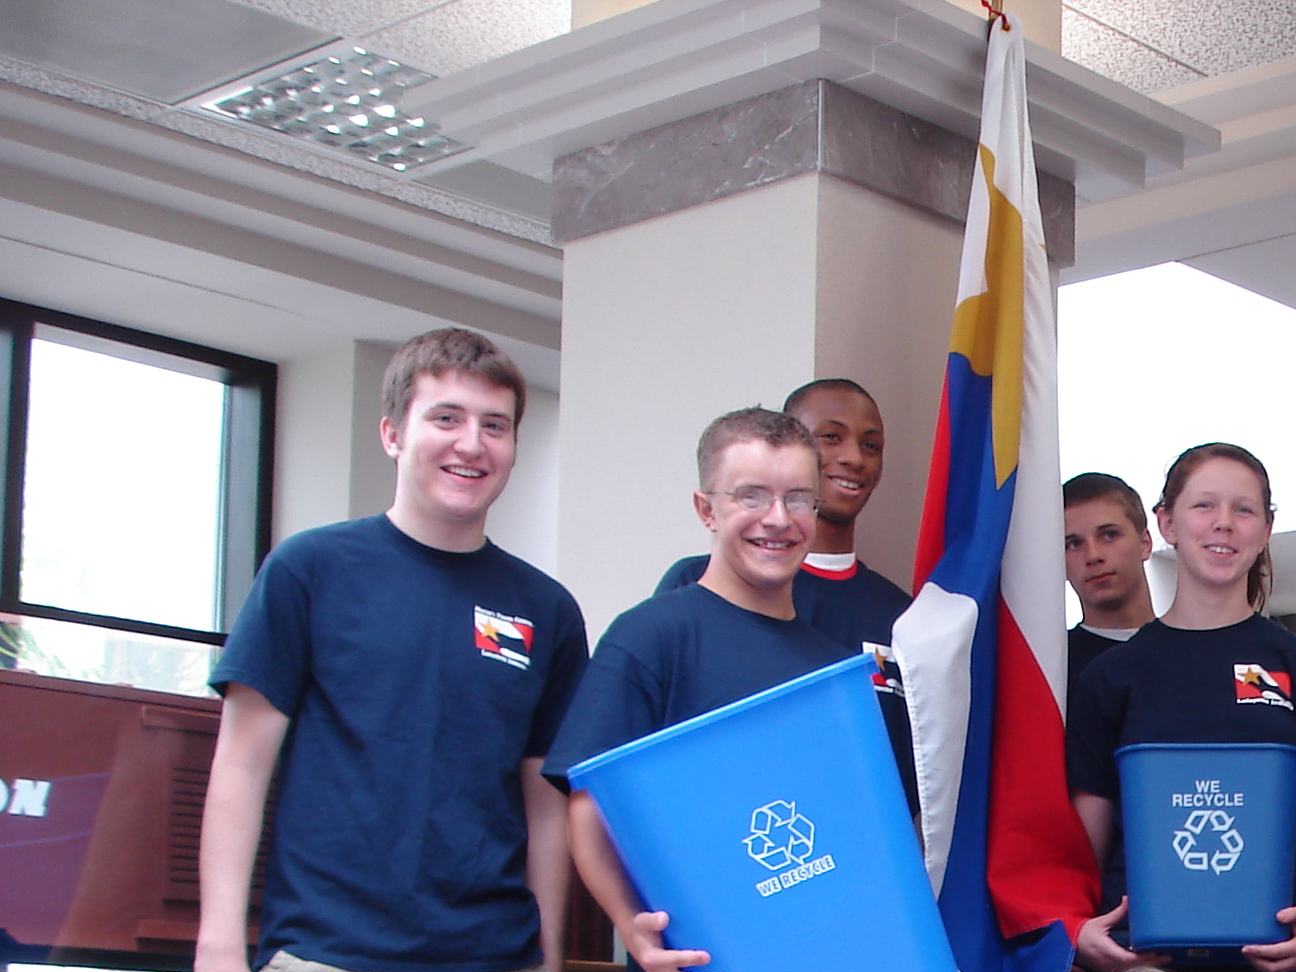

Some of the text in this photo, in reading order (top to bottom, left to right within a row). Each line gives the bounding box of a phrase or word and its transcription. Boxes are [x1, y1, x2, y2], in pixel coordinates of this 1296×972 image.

[0, 777, 51, 817] N
[1195, 779, 1221, 793] WE
[1172, 793, 1244, 807] RECYCLE
[755, 854, 836, 897] WE RECYCLE
